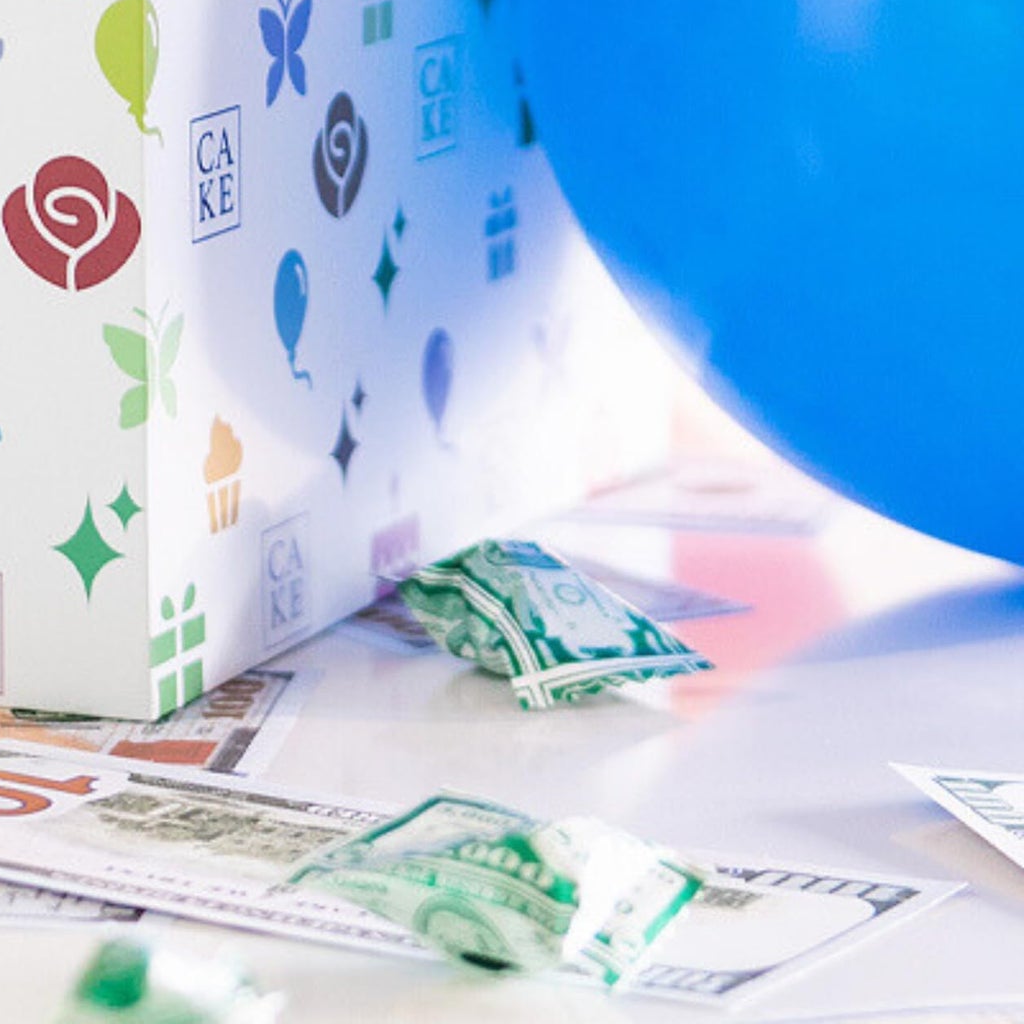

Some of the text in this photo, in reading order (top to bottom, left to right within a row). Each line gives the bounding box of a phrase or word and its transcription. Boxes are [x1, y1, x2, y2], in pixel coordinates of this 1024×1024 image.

[196, 126, 234, 174] CA
[199, 173, 234, 222] KE
[268, 537, 303, 582] CA
[270, 577, 304, 630] KE
